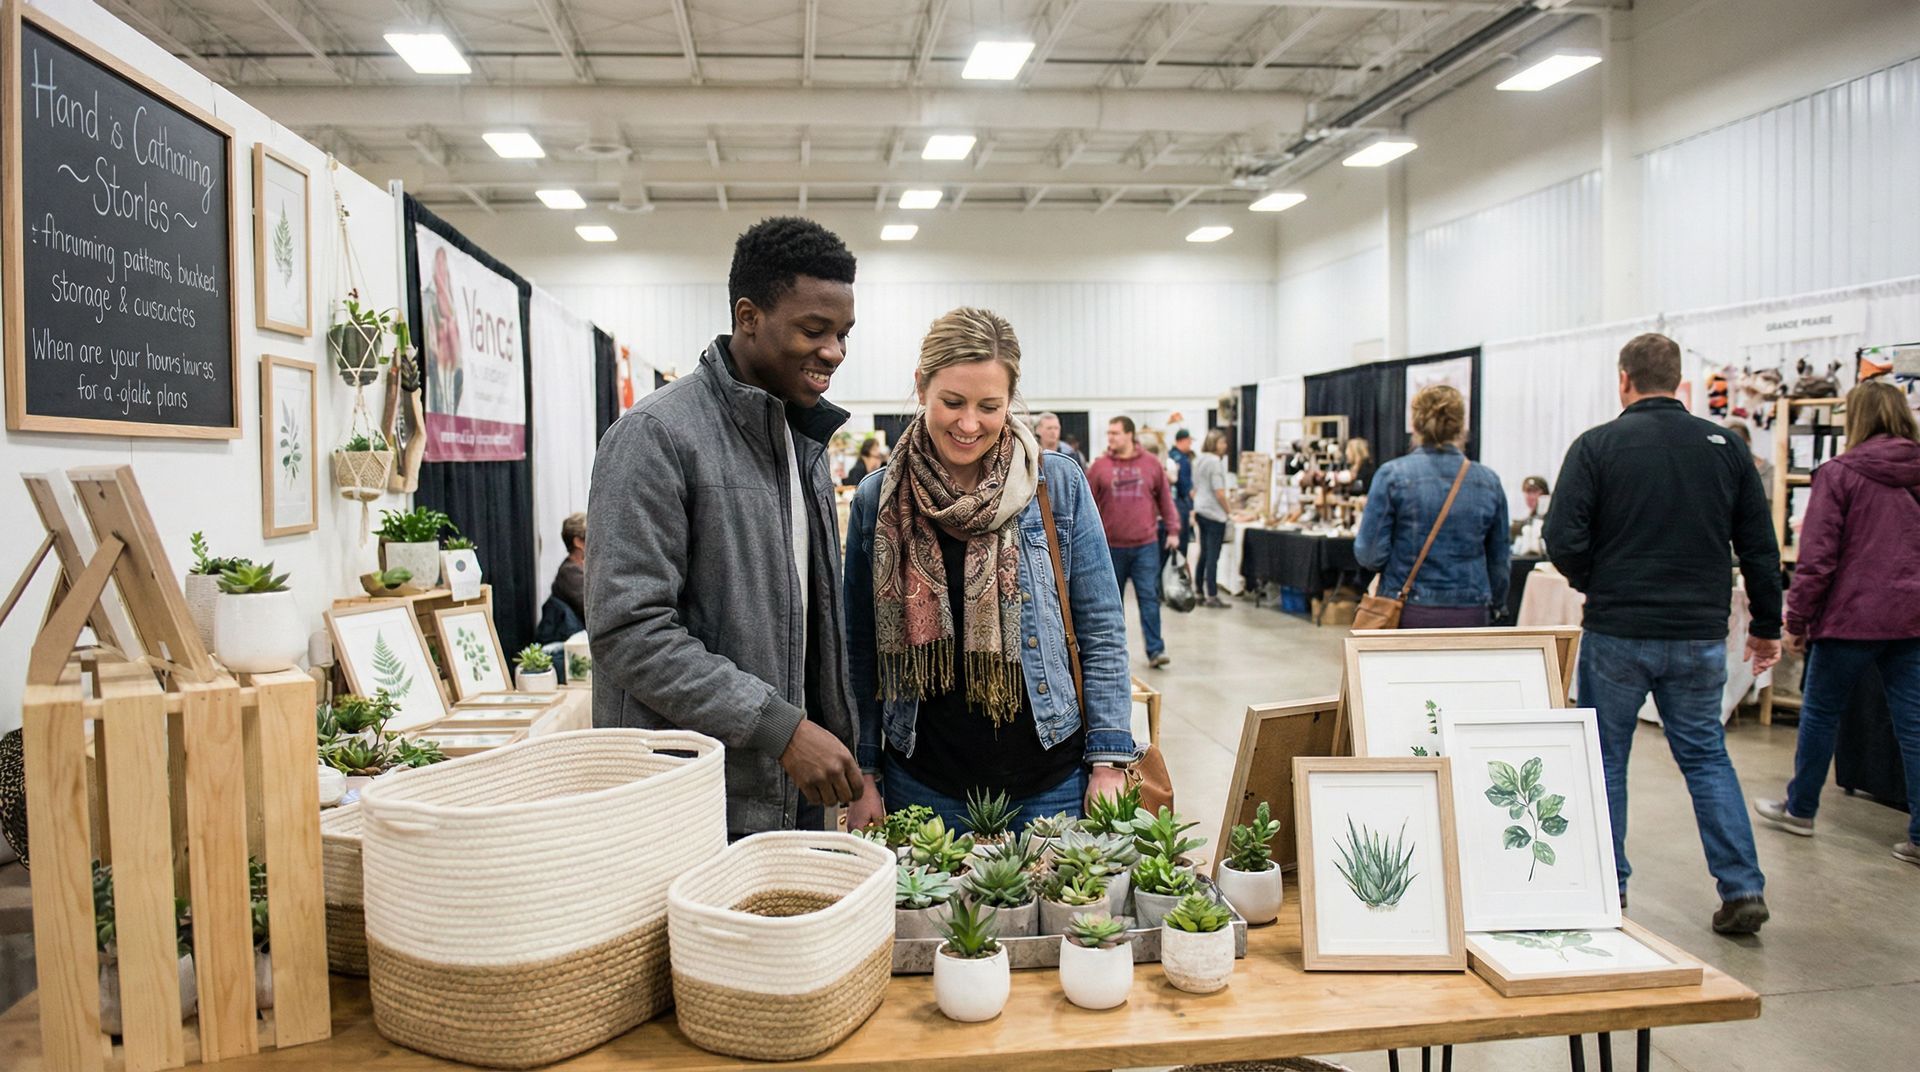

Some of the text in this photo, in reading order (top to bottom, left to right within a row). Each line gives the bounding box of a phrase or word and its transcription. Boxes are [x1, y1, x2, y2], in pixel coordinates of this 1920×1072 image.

[31, 48, 99, 141] Hand
[118, 285, 128, 314] &
[32, 327, 74, 361] When
[79, 344, 104, 365] are
[110, 348, 141, 380] your
[77, 373, 98, 400] for
[104, 386, 113, 401] a
[157, 383, 188, 416] plans
